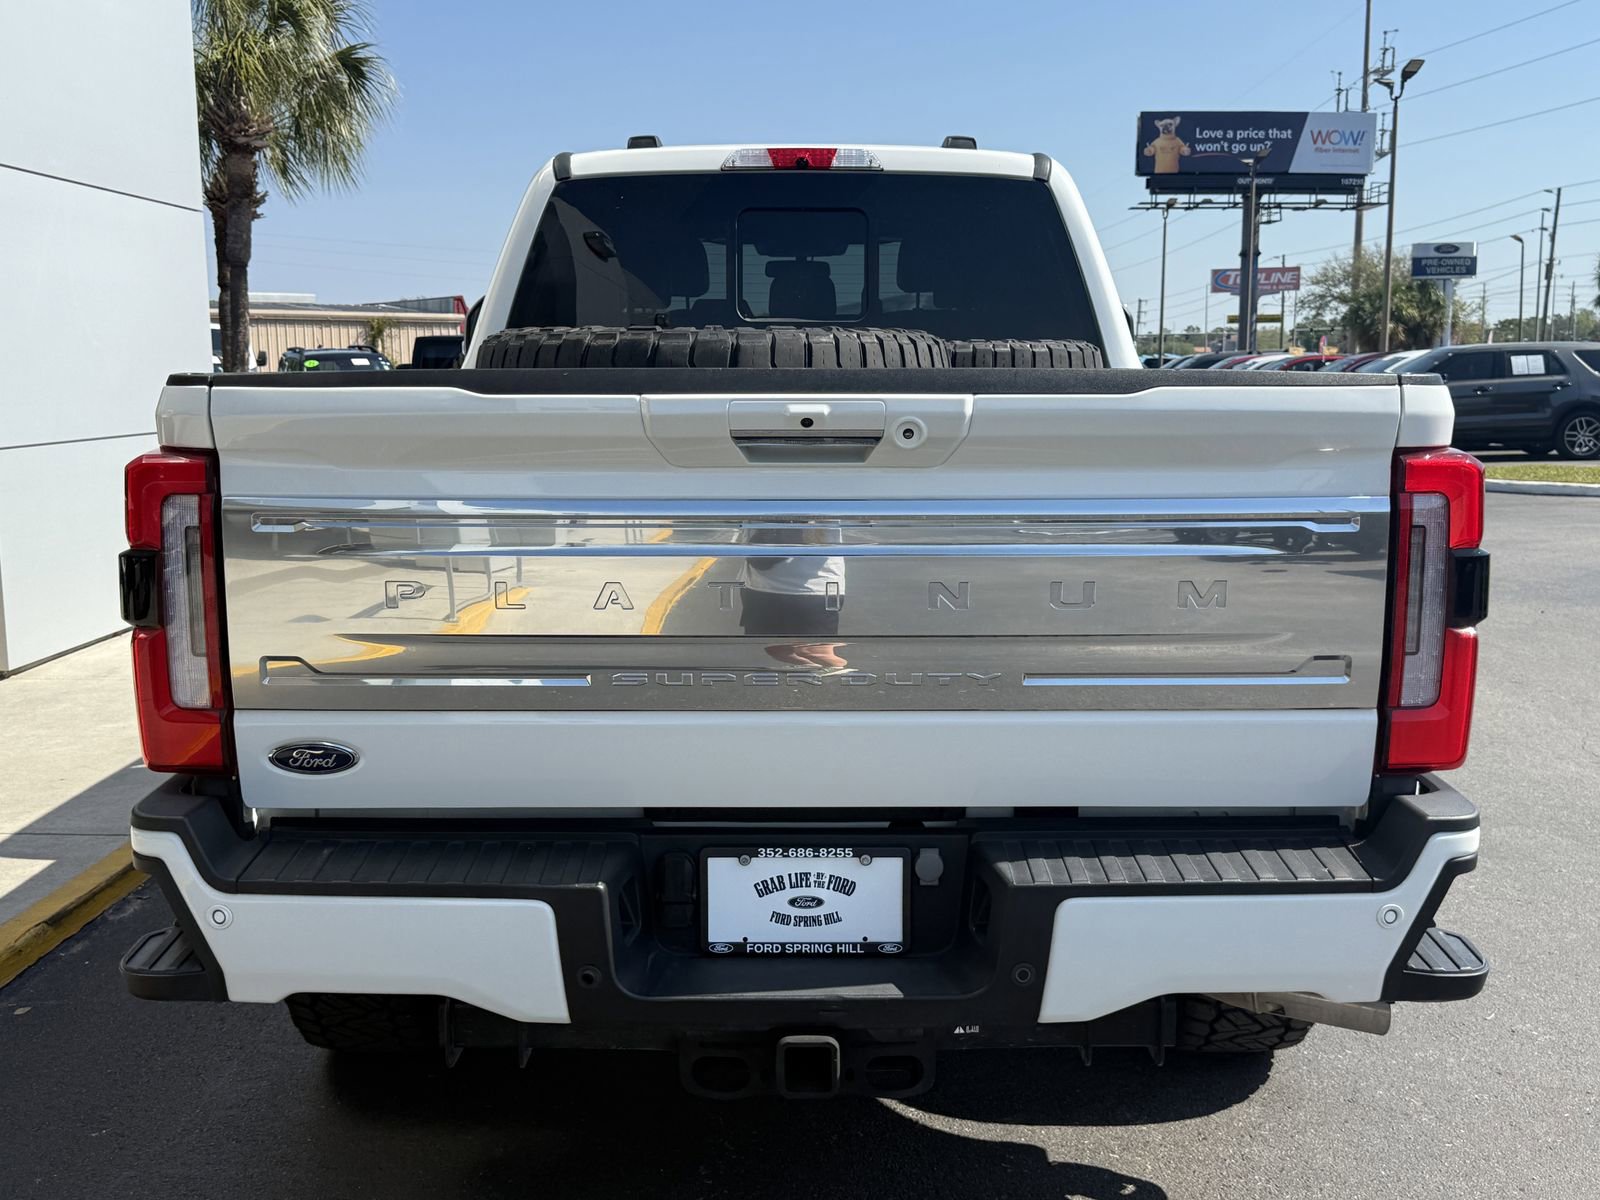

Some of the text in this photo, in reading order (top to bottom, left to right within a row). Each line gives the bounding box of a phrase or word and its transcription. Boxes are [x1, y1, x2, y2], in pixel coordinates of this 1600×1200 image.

[1195, 128, 1292, 140] Love a price that
[1310, 130, 1366, 146] WOW!
[1195, 141, 1228, 152] won't
[1231, 143, 1247, 154] go
[1426, 266, 1466, 274] VEHICLES
[1227, 271, 1298, 285] TLINE
[385, 580, 1227, 611] PLATINUM
[611, 672, 1001, 687] SUPER DUTY
[289, 749, 337, 769] Ford
[757, 847, 854, 858] 352-686-8255
[753, 871, 857, 898] GRAB LIFE BY THE FORD
[794, 896, 818, 907] Ford
[769, 910, 843, 928] FORD SPRING HILL
[746, 943, 865, 954] FORD SPRING HILL
